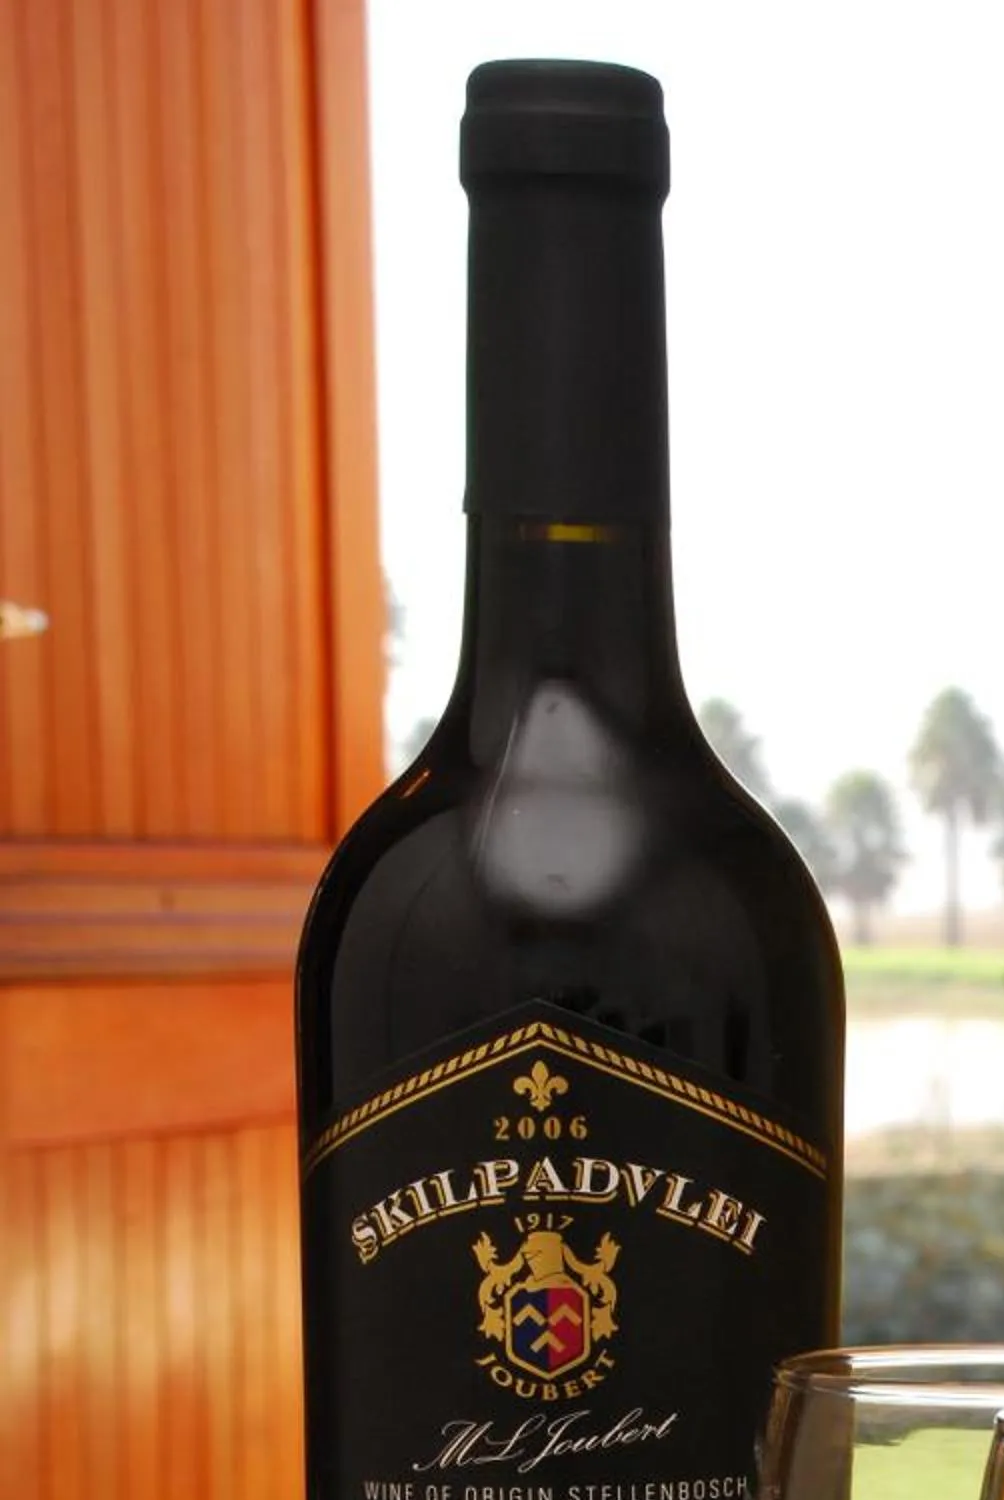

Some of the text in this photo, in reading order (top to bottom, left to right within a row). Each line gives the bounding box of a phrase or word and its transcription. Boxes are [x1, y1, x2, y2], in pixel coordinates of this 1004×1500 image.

[494, 1115, 588, 1140] 2006
[350, 1156, 768, 1264] SKILPADVLEI
[514, 1212, 575, 1233] 1917
[475, 1350, 616, 1401] JOUBERT
[517, 1407, 679, 1474] Joubert
